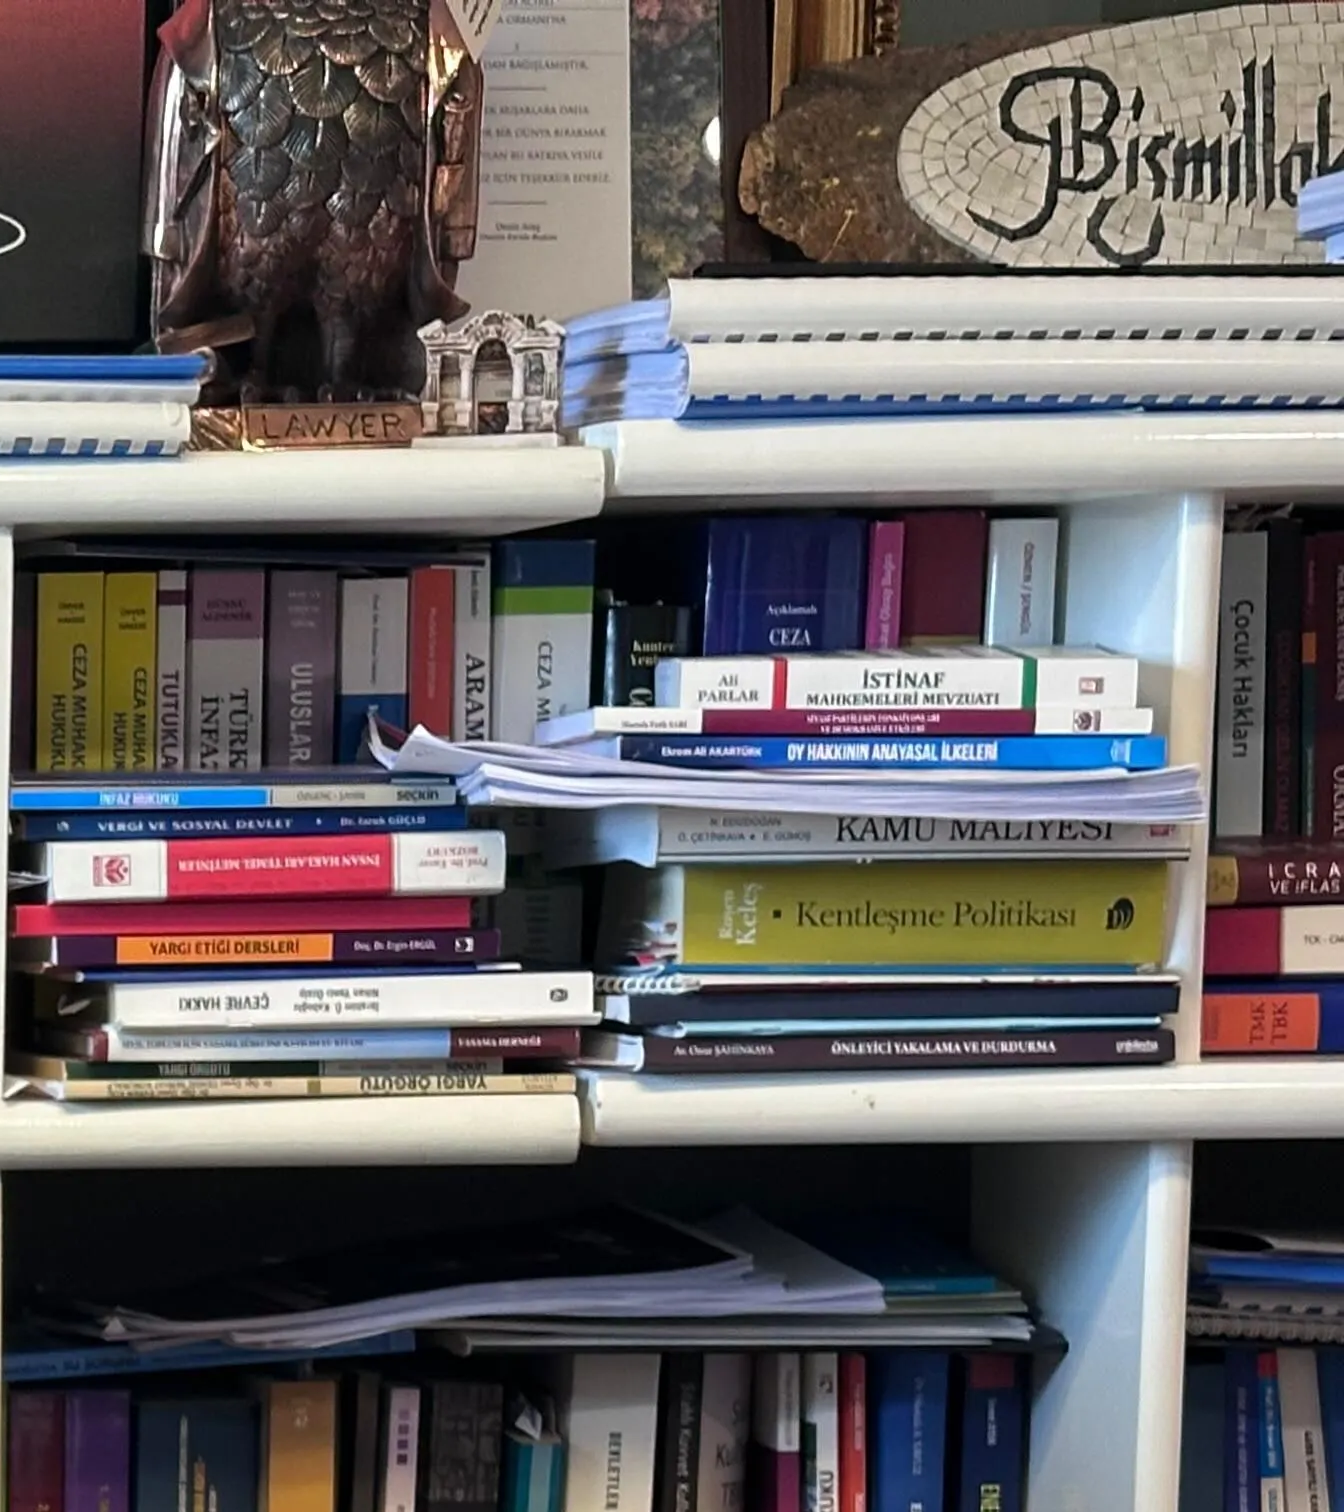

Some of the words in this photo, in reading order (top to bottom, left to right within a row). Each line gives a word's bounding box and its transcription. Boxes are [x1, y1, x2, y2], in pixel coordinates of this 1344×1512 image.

[262, 413, 406, 440] LAWYER
[769, 629, 810, 647] CEZA
[1231, 599, 1255, 671] Çocuk
[72, 643, 87, 690] CEZA
[537, 641, 553, 691] CEZA
[133, 667, 146, 710] CEZA
[718, 674, 739, 688] Ali
[862, 668, 945, 689] İSTİNAF
[697, 689, 759, 703] PARLAR
[806, 692, 919, 706] MAHKEMELERİ
[923, 692, 1000, 706] MEVZUATI
[162, 670, 179, 769] TUTUKLA
[289, 663, 314, 765] ULUSLAR
[1231, 677, 1255, 759] Hakları
[72, 695, 87, 767] MUHAK
[229, 688, 254, 770] TÜRK
[787, 740, 805, 763] OY
[807, 740, 868, 763] HAKKININ
[870, 740, 939, 763] ANAYASAL
[941, 740, 998, 763] İLKELERİ
[97, 820, 144, 833] VERGİ
[148, 820, 168, 832] VE
[171, 819, 229, 832] SOSYAL
[236, 817, 293, 830] DEVLET
[835, 817, 936, 841] KAMU
[243, 858, 282, 870] TEMEL
[285, 856, 339, 869] HAKLARI
[342, 854, 380, 866] İNSAN
[1270, 879, 1289, 894] VE
[735, 883, 763, 944] Keleş
[797, 901, 945, 934] Kentleşme
[953, 901, 1076, 928] Politikası
[149, 942, 192, 956] YARGI
[195, 939, 231, 955] ETİĞİ
[235, 939, 300, 954] DERSLERİ
[179, 997, 221, 1011] HAKKI
[226, 992, 270, 1011] ÇEVRE
[831, 1040, 892, 1055] ÖNLEYİCİ
[894, 1040, 964, 1055] YAKALAMA
[966, 1040, 979, 1055] VE
[982, 1040, 1056, 1055] DURDURMA
[360, 1074, 430, 1093] ÖRGÜTÜ
[436, 1074, 487, 1093] YARGI
